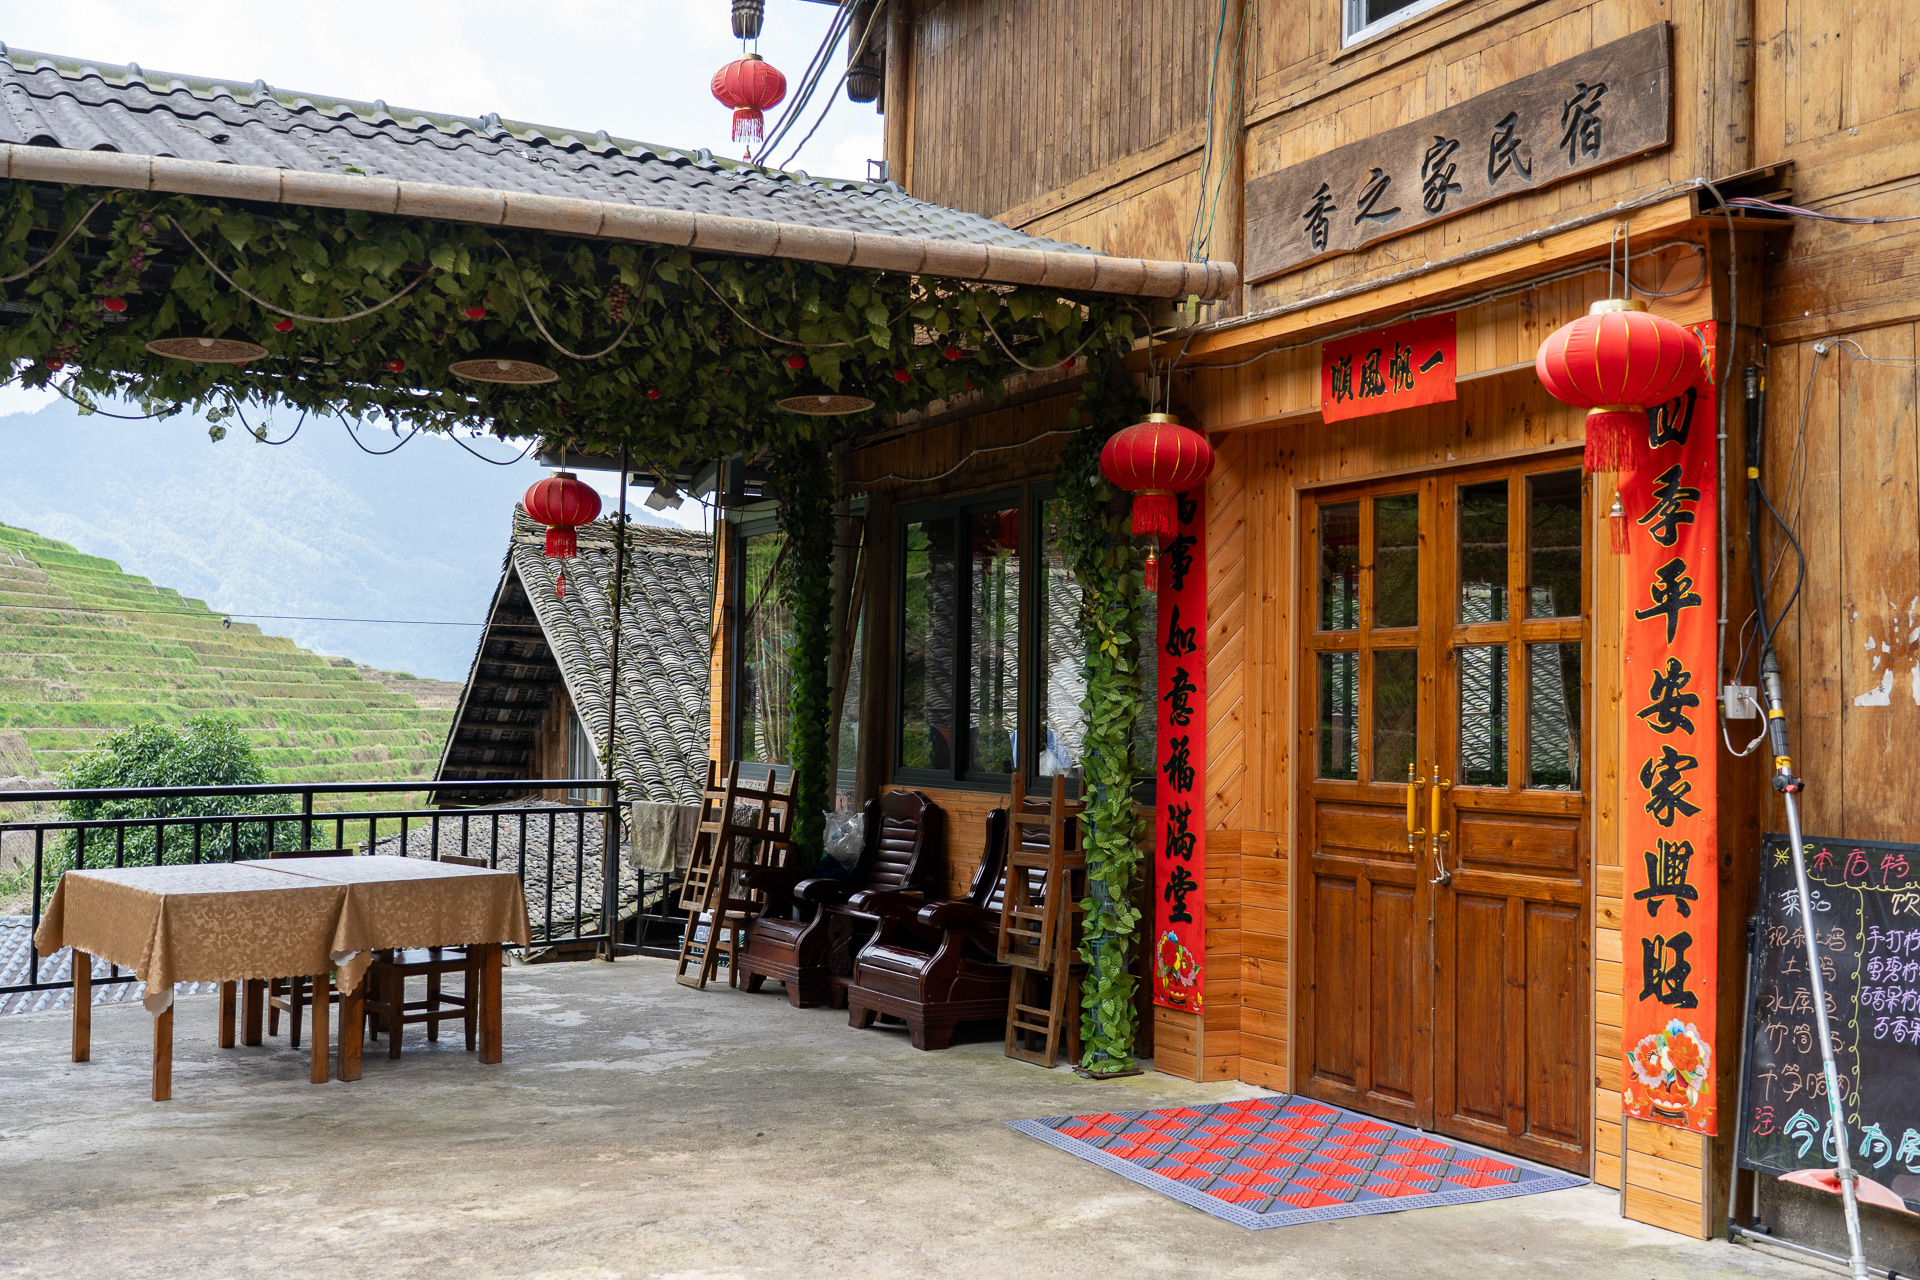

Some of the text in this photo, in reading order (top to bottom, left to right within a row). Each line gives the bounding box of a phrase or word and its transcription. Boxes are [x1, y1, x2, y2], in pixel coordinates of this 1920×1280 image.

[1302, 82, 1608, 252] 香之家民宿
[1633, 387, 1702, 1009] 四季平安家興旺
